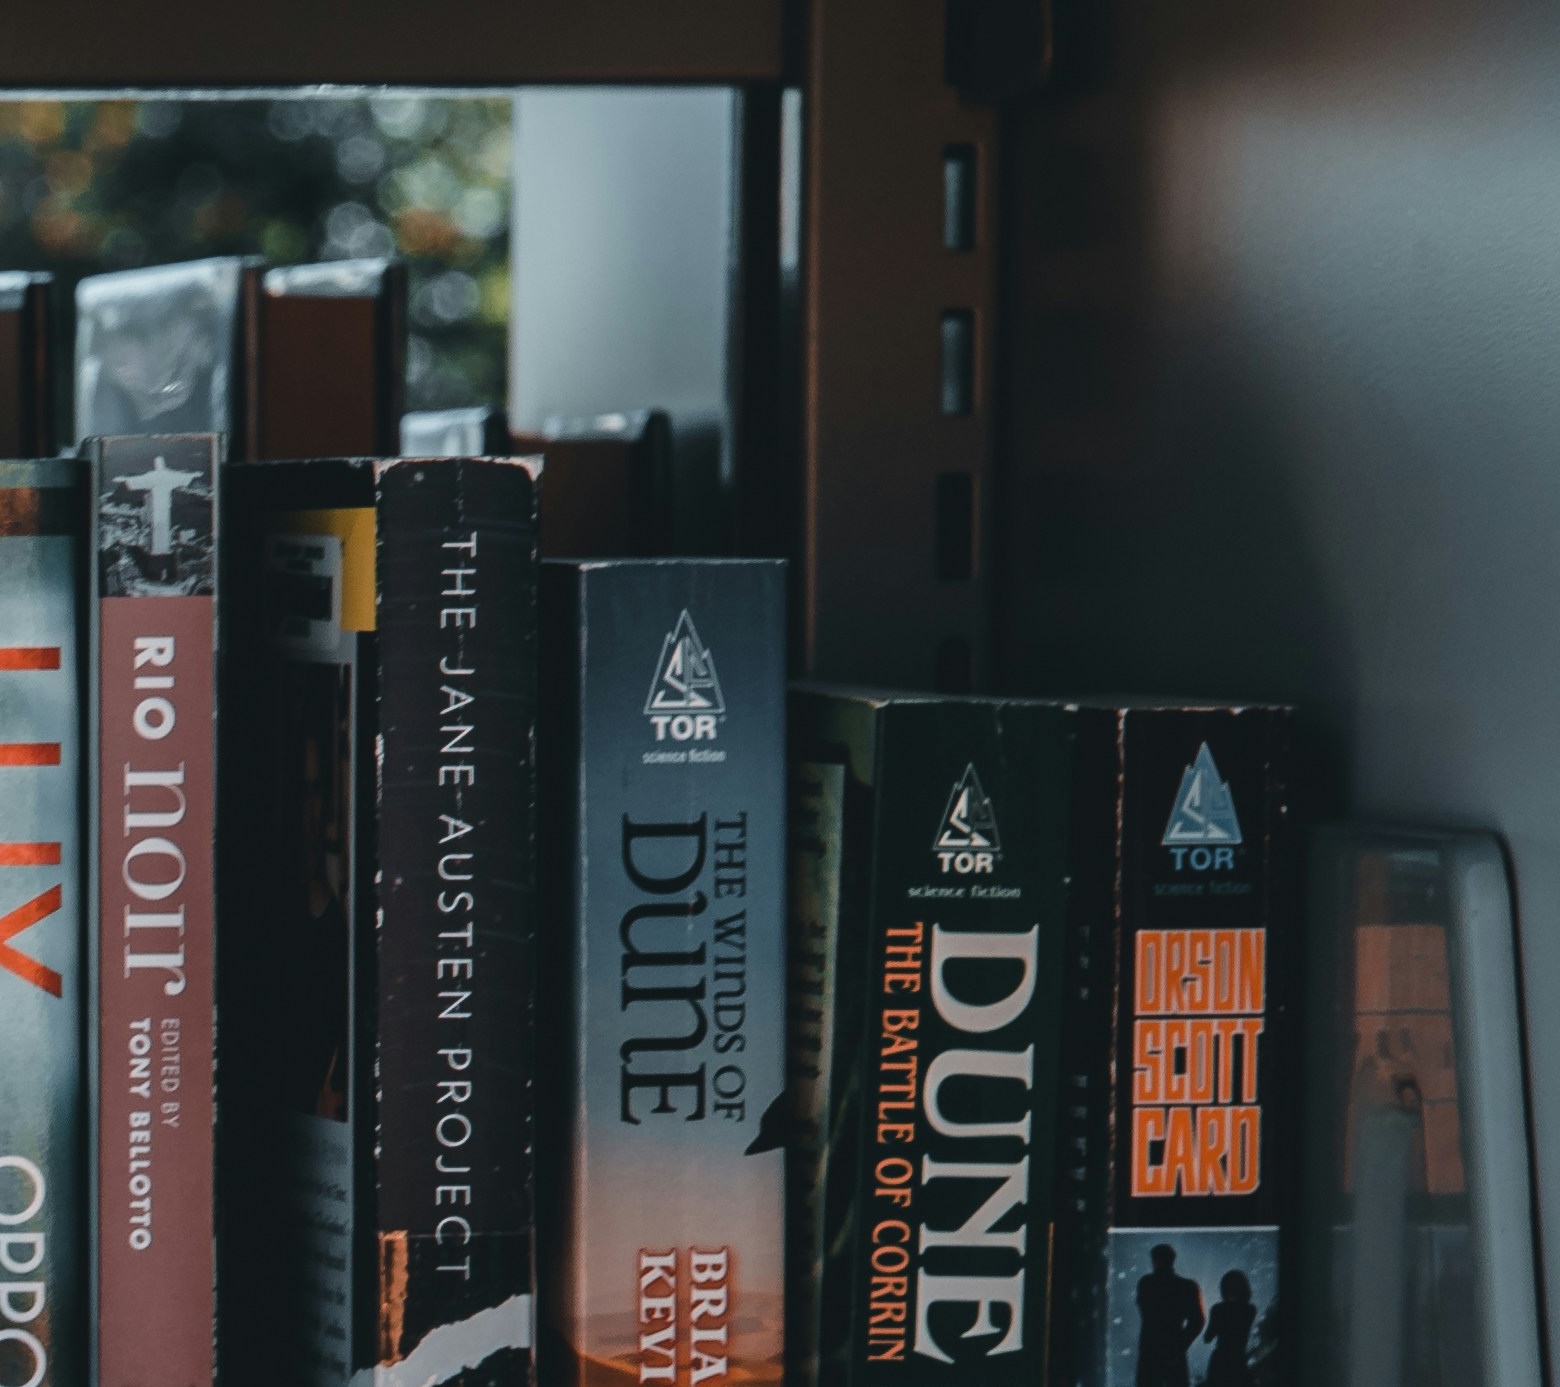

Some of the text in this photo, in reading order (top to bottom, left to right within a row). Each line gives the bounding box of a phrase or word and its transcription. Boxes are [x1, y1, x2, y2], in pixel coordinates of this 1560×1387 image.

[650, 716, 717, 742] TOR
[938, 852, 994, 874] TOR
[1170, 847, 1235, 872] TOR
[1132, 928, 1268, 1016] ORSON
[160, 1017, 182, 1129] EDITED BY
[1132, 1019, 1266, 1106] SCOTT
[128, 1017, 153, 1252] TONY BELLOTTO
[869, 921, 922, 1363] THE BATTLE OF CORRIN
[916, 923, 1040, 1364] DUNE
[1131, 1108, 1262, 1198] CARD
